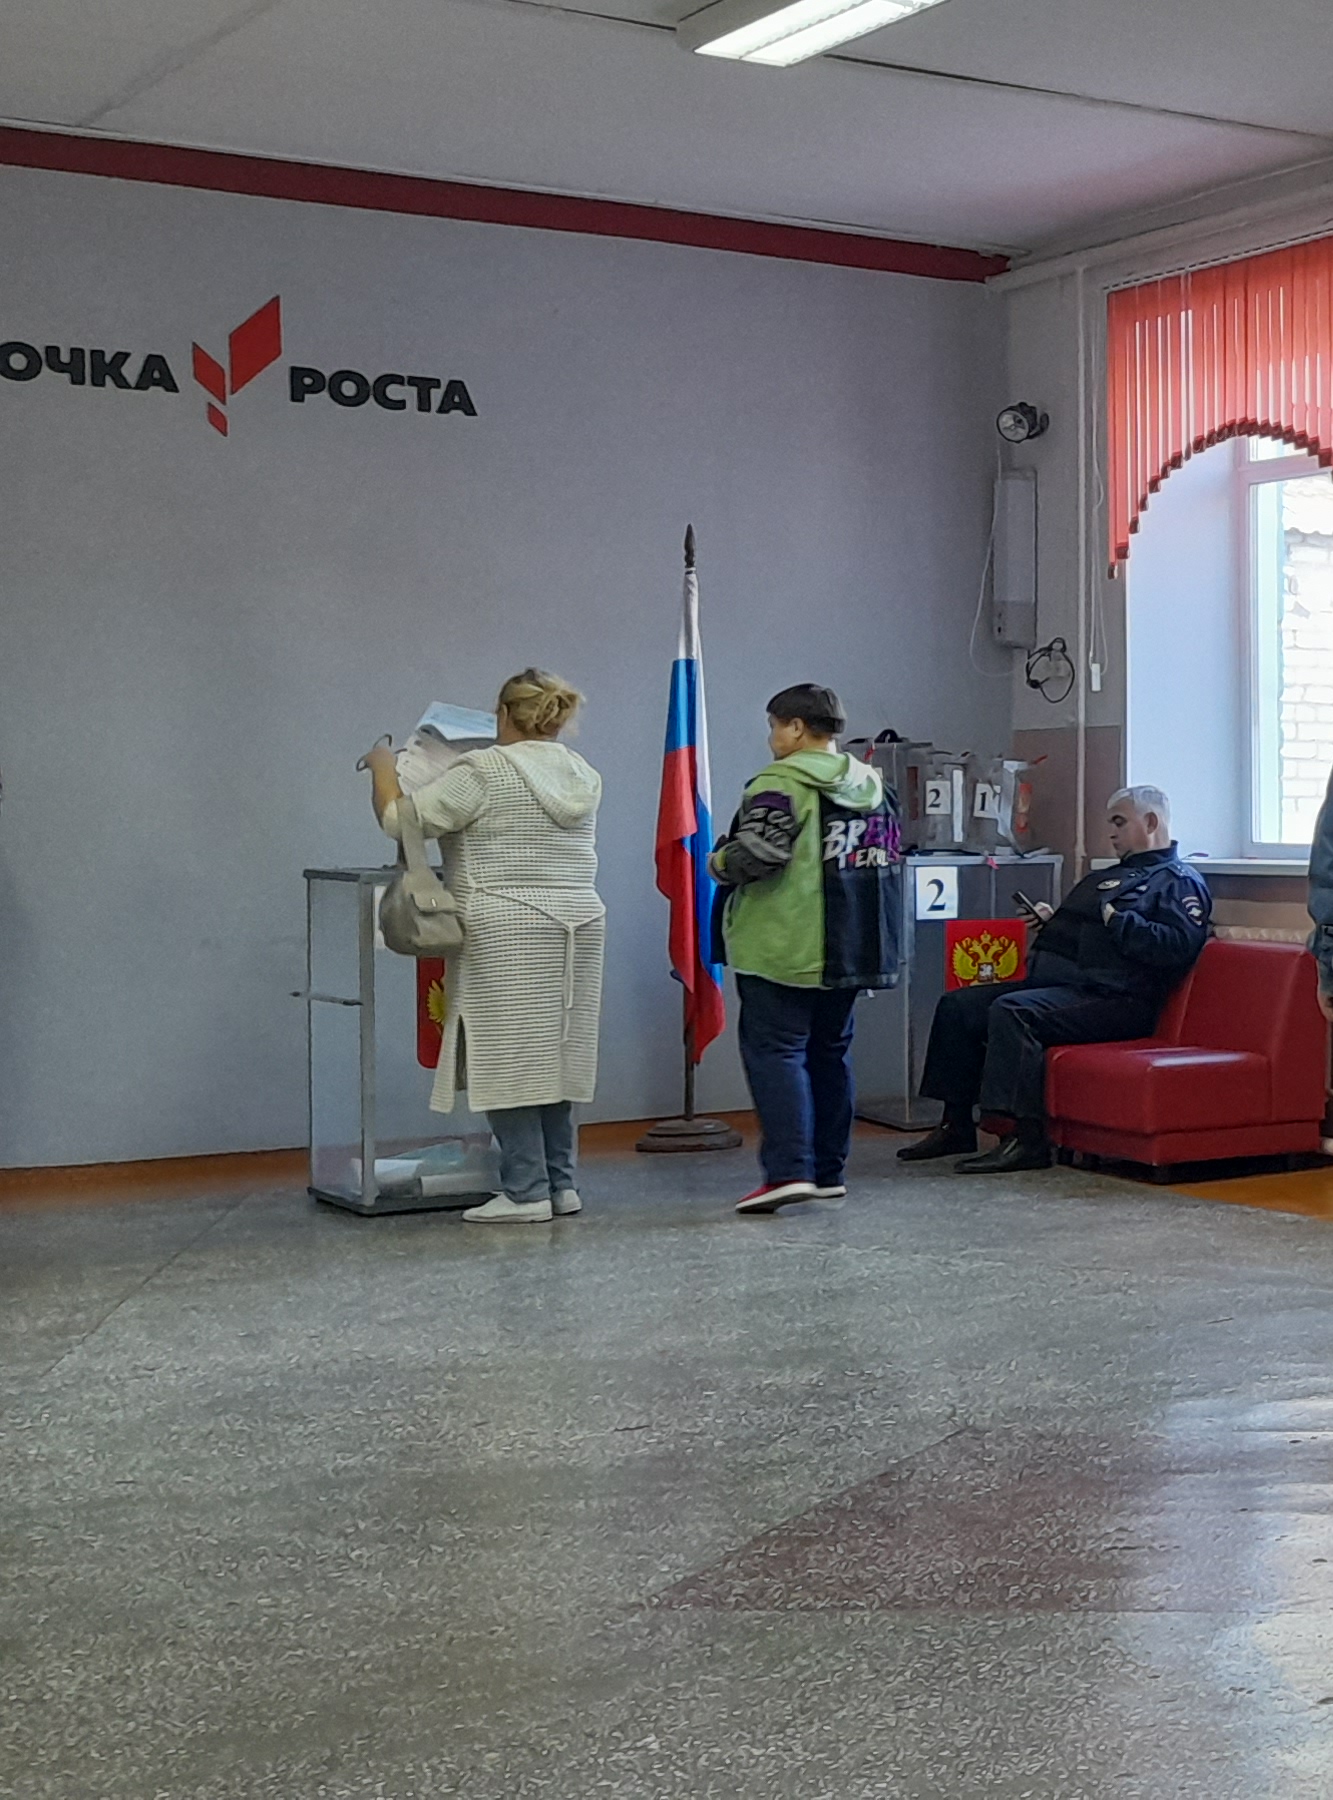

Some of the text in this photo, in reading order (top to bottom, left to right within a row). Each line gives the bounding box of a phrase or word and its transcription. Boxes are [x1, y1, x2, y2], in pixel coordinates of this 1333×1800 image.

[289, 366, 478, 416] РОСТА
[928, 788, 941, 808] 2
[979, 791, 987, 811] 1
[926, 878, 946, 912] 2
